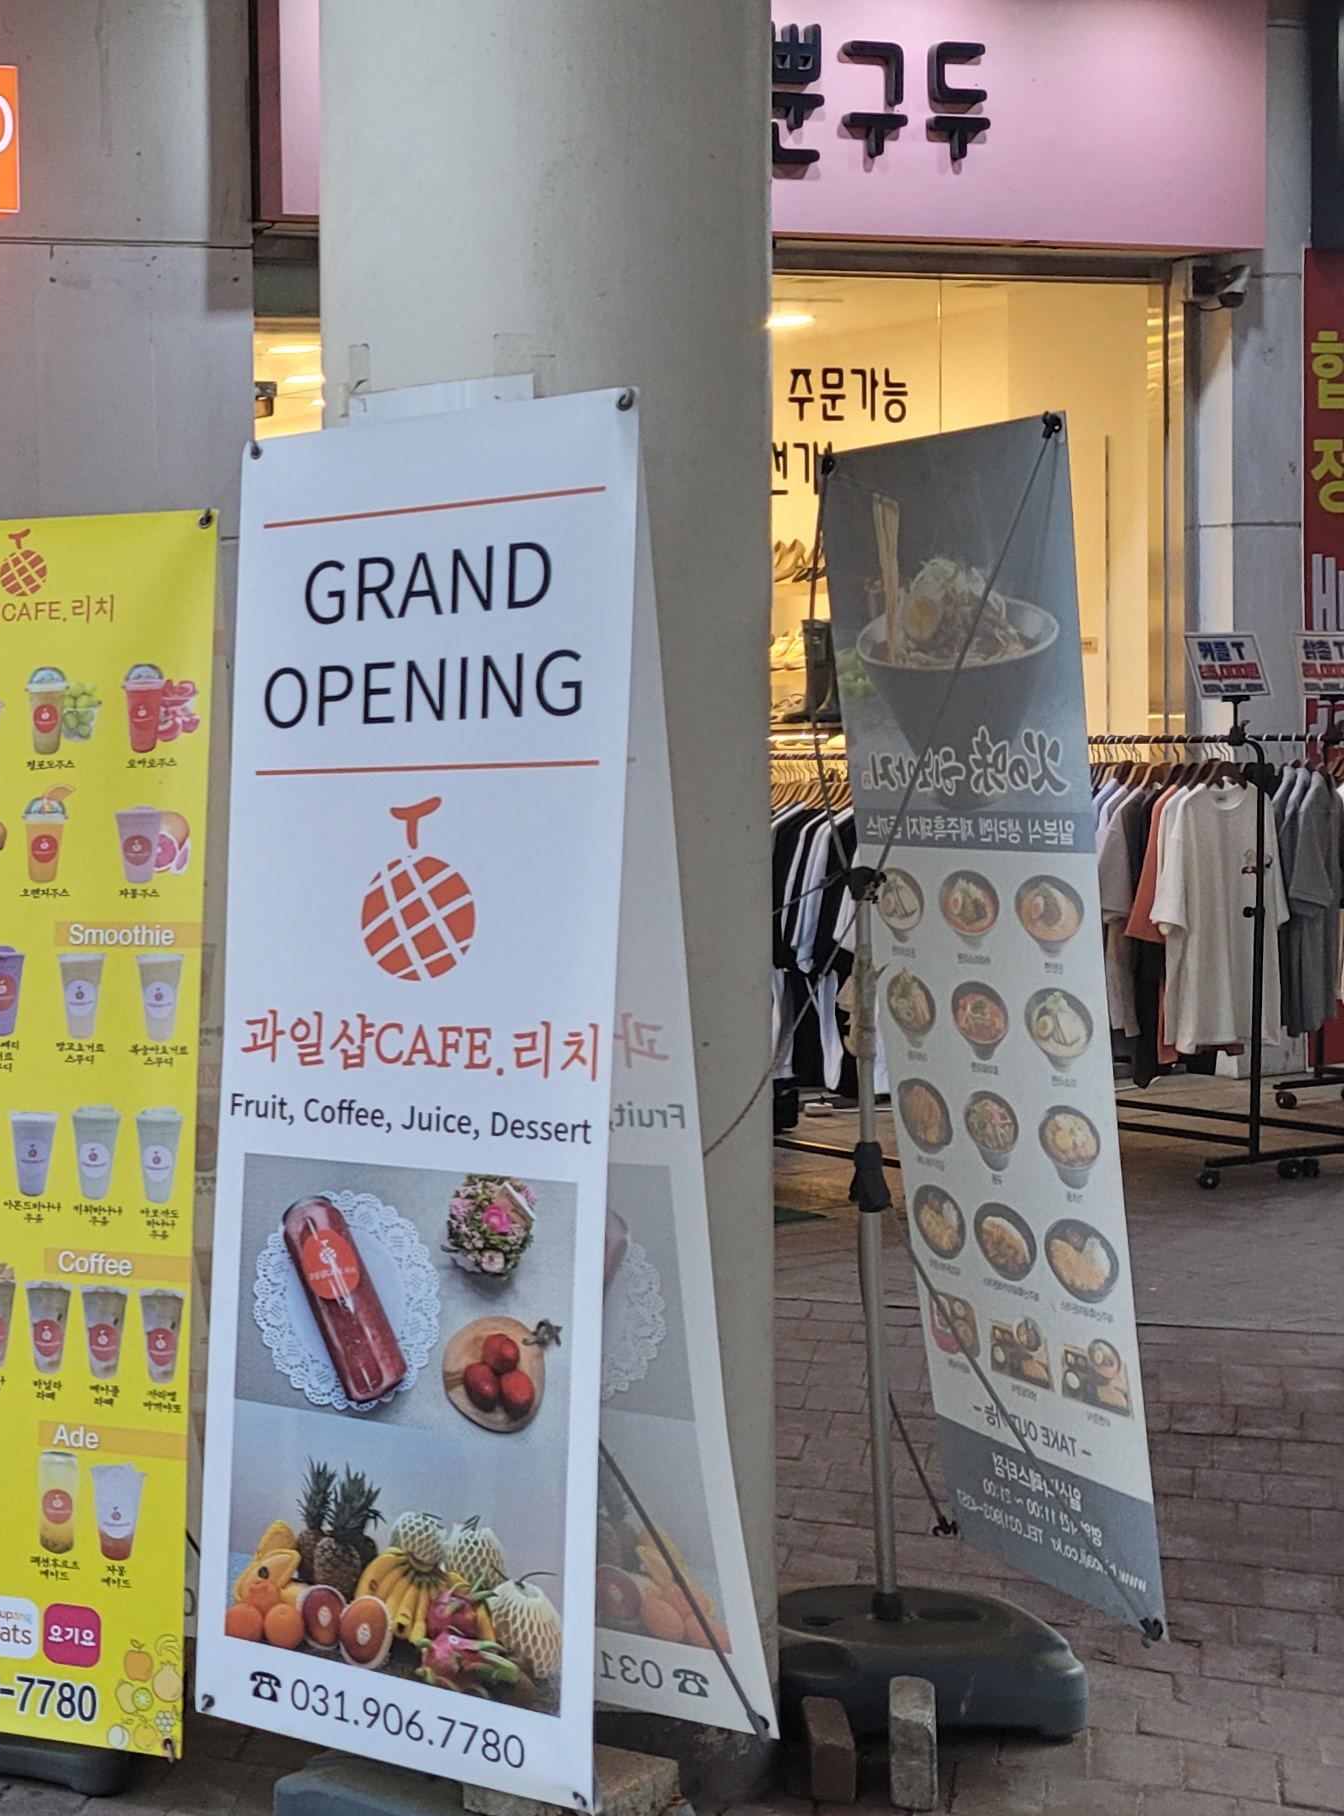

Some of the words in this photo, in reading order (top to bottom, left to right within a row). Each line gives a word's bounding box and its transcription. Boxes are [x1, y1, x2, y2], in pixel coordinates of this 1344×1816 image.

[788, 367, 909, 424] 주문가능
[303, 541, 553, 626] GRAND
[263, 648, 584, 730] OPENING
[67, 923, 176, 946] Smoothie
[240, 1006, 601, 1082] 과일샵CAFE.리치
[229, 1091, 295, 1127] Fruit,
[302, 1096, 393, 1132] Coffee,
[402, 1103, 481, 1142] Juice,
[489, 1110, 593, 1147] Dessert
[57, 1250, 134, 1277] Coffee
[52, 1423, 100, 1450] Ade
[47, 1624, 97, 1649] 요기요
[289, 1678, 527, 1770] 031.906.7780
